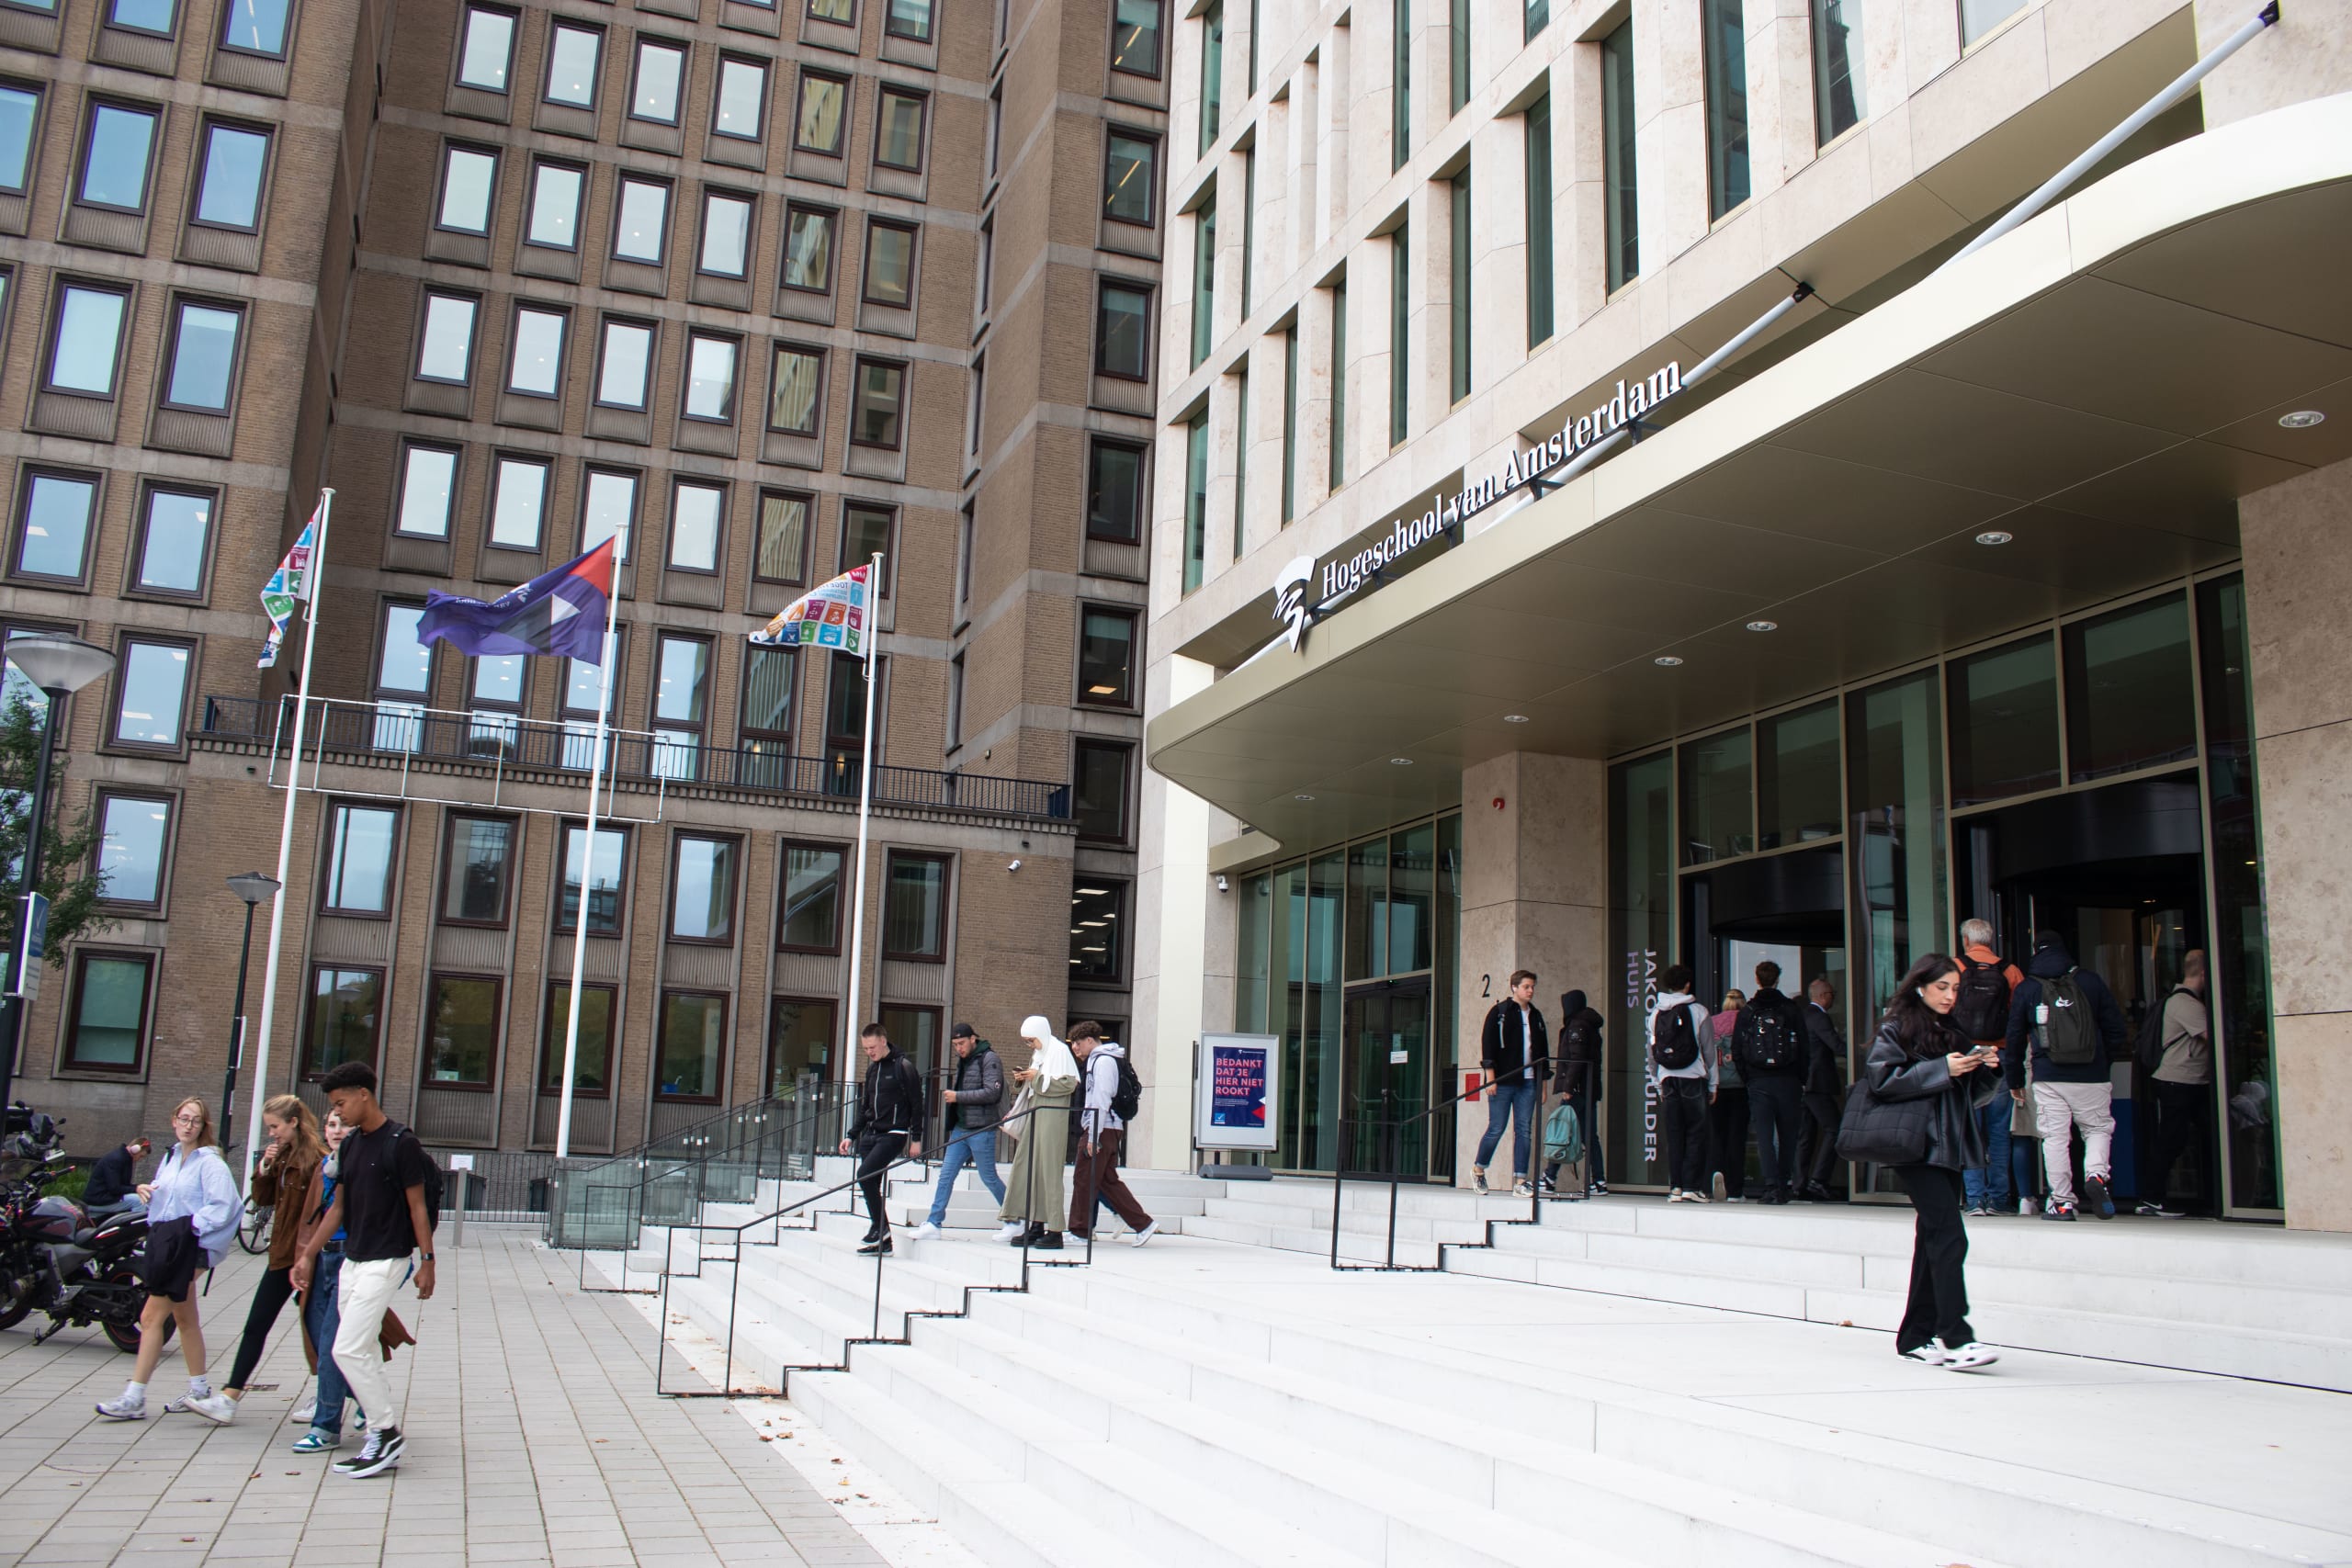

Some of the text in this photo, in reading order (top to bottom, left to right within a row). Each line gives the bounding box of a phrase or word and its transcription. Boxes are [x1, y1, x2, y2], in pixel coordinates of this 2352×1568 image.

[1321, 360, 1683, 600] Hogeschool van Amsterdam
[1482, 974, 1490, 998] 2
[1627, 951, 1639, 1009] HUIS
[1645, 948, 1657, 1049] JAKO
[1216, 1058, 1262, 1067] BEDANKT
[1216, 1067, 1235, 1076] DAT
[1216, 1086, 1250, 1095] ROOKT
[1241, 1077, 1263, 1087] NIET
